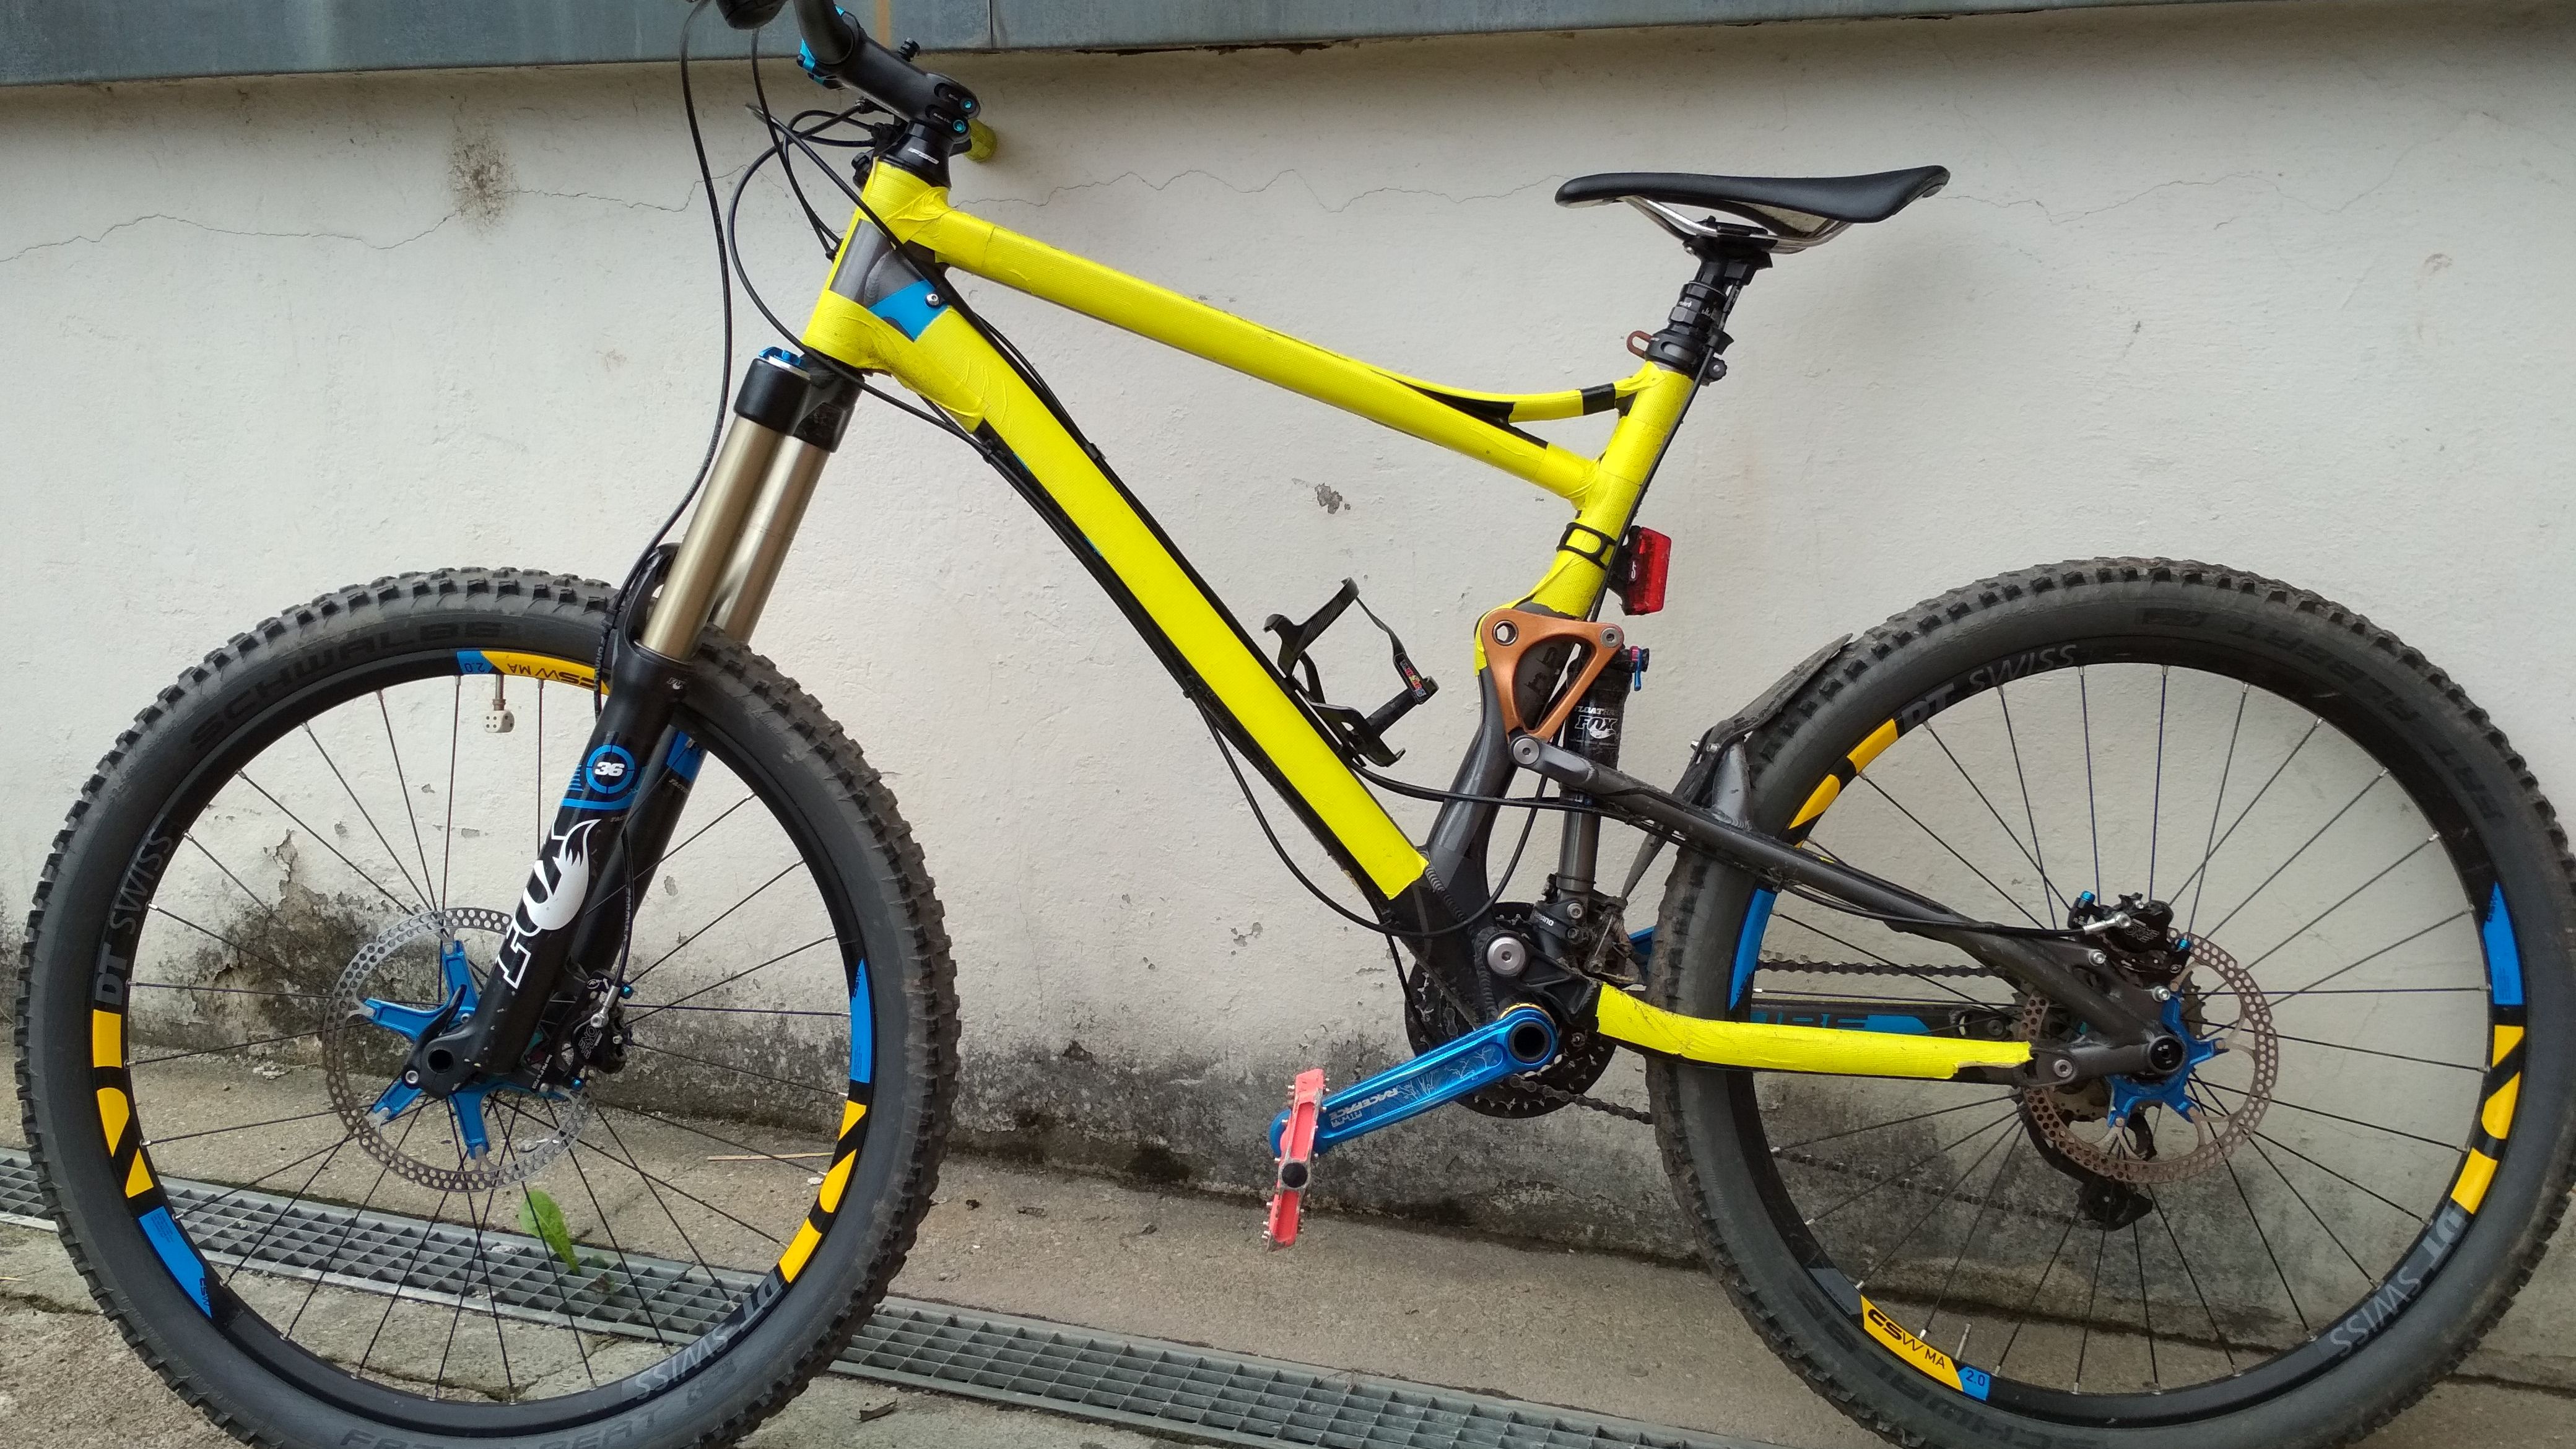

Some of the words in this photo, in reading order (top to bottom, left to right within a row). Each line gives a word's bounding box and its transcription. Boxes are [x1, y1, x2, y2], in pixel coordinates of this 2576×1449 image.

[189, 621, 501, 753] SCHWALBE
[465, 662, 485, 673] 2.0
[507, 663, 531, 674] MA
[1901, 683, 1957, 728] DT
[1968, 643, 2078, 695] SWISS
[1575, 715, 1618, 736] FOX
[594, 761, 625, 777] 36
[110, 827, 175, 935] SWISS
[96, 942, 129, 1006] DT
[1329, 1088, 1398, 1119] RACEFACE
[2420, 1207, 2466, 1273] DT
[737, 1277, 784, 1331] DT
[2330, 1265, 2424, 1355] SWISS
[635, 1333, 731, 1401] SWISS
[1868, 1308, 1923, 1352] CSW
[1925, 1349, 1946, 1370] MA
[1965, 1370, 1986, 1387] 2.0
